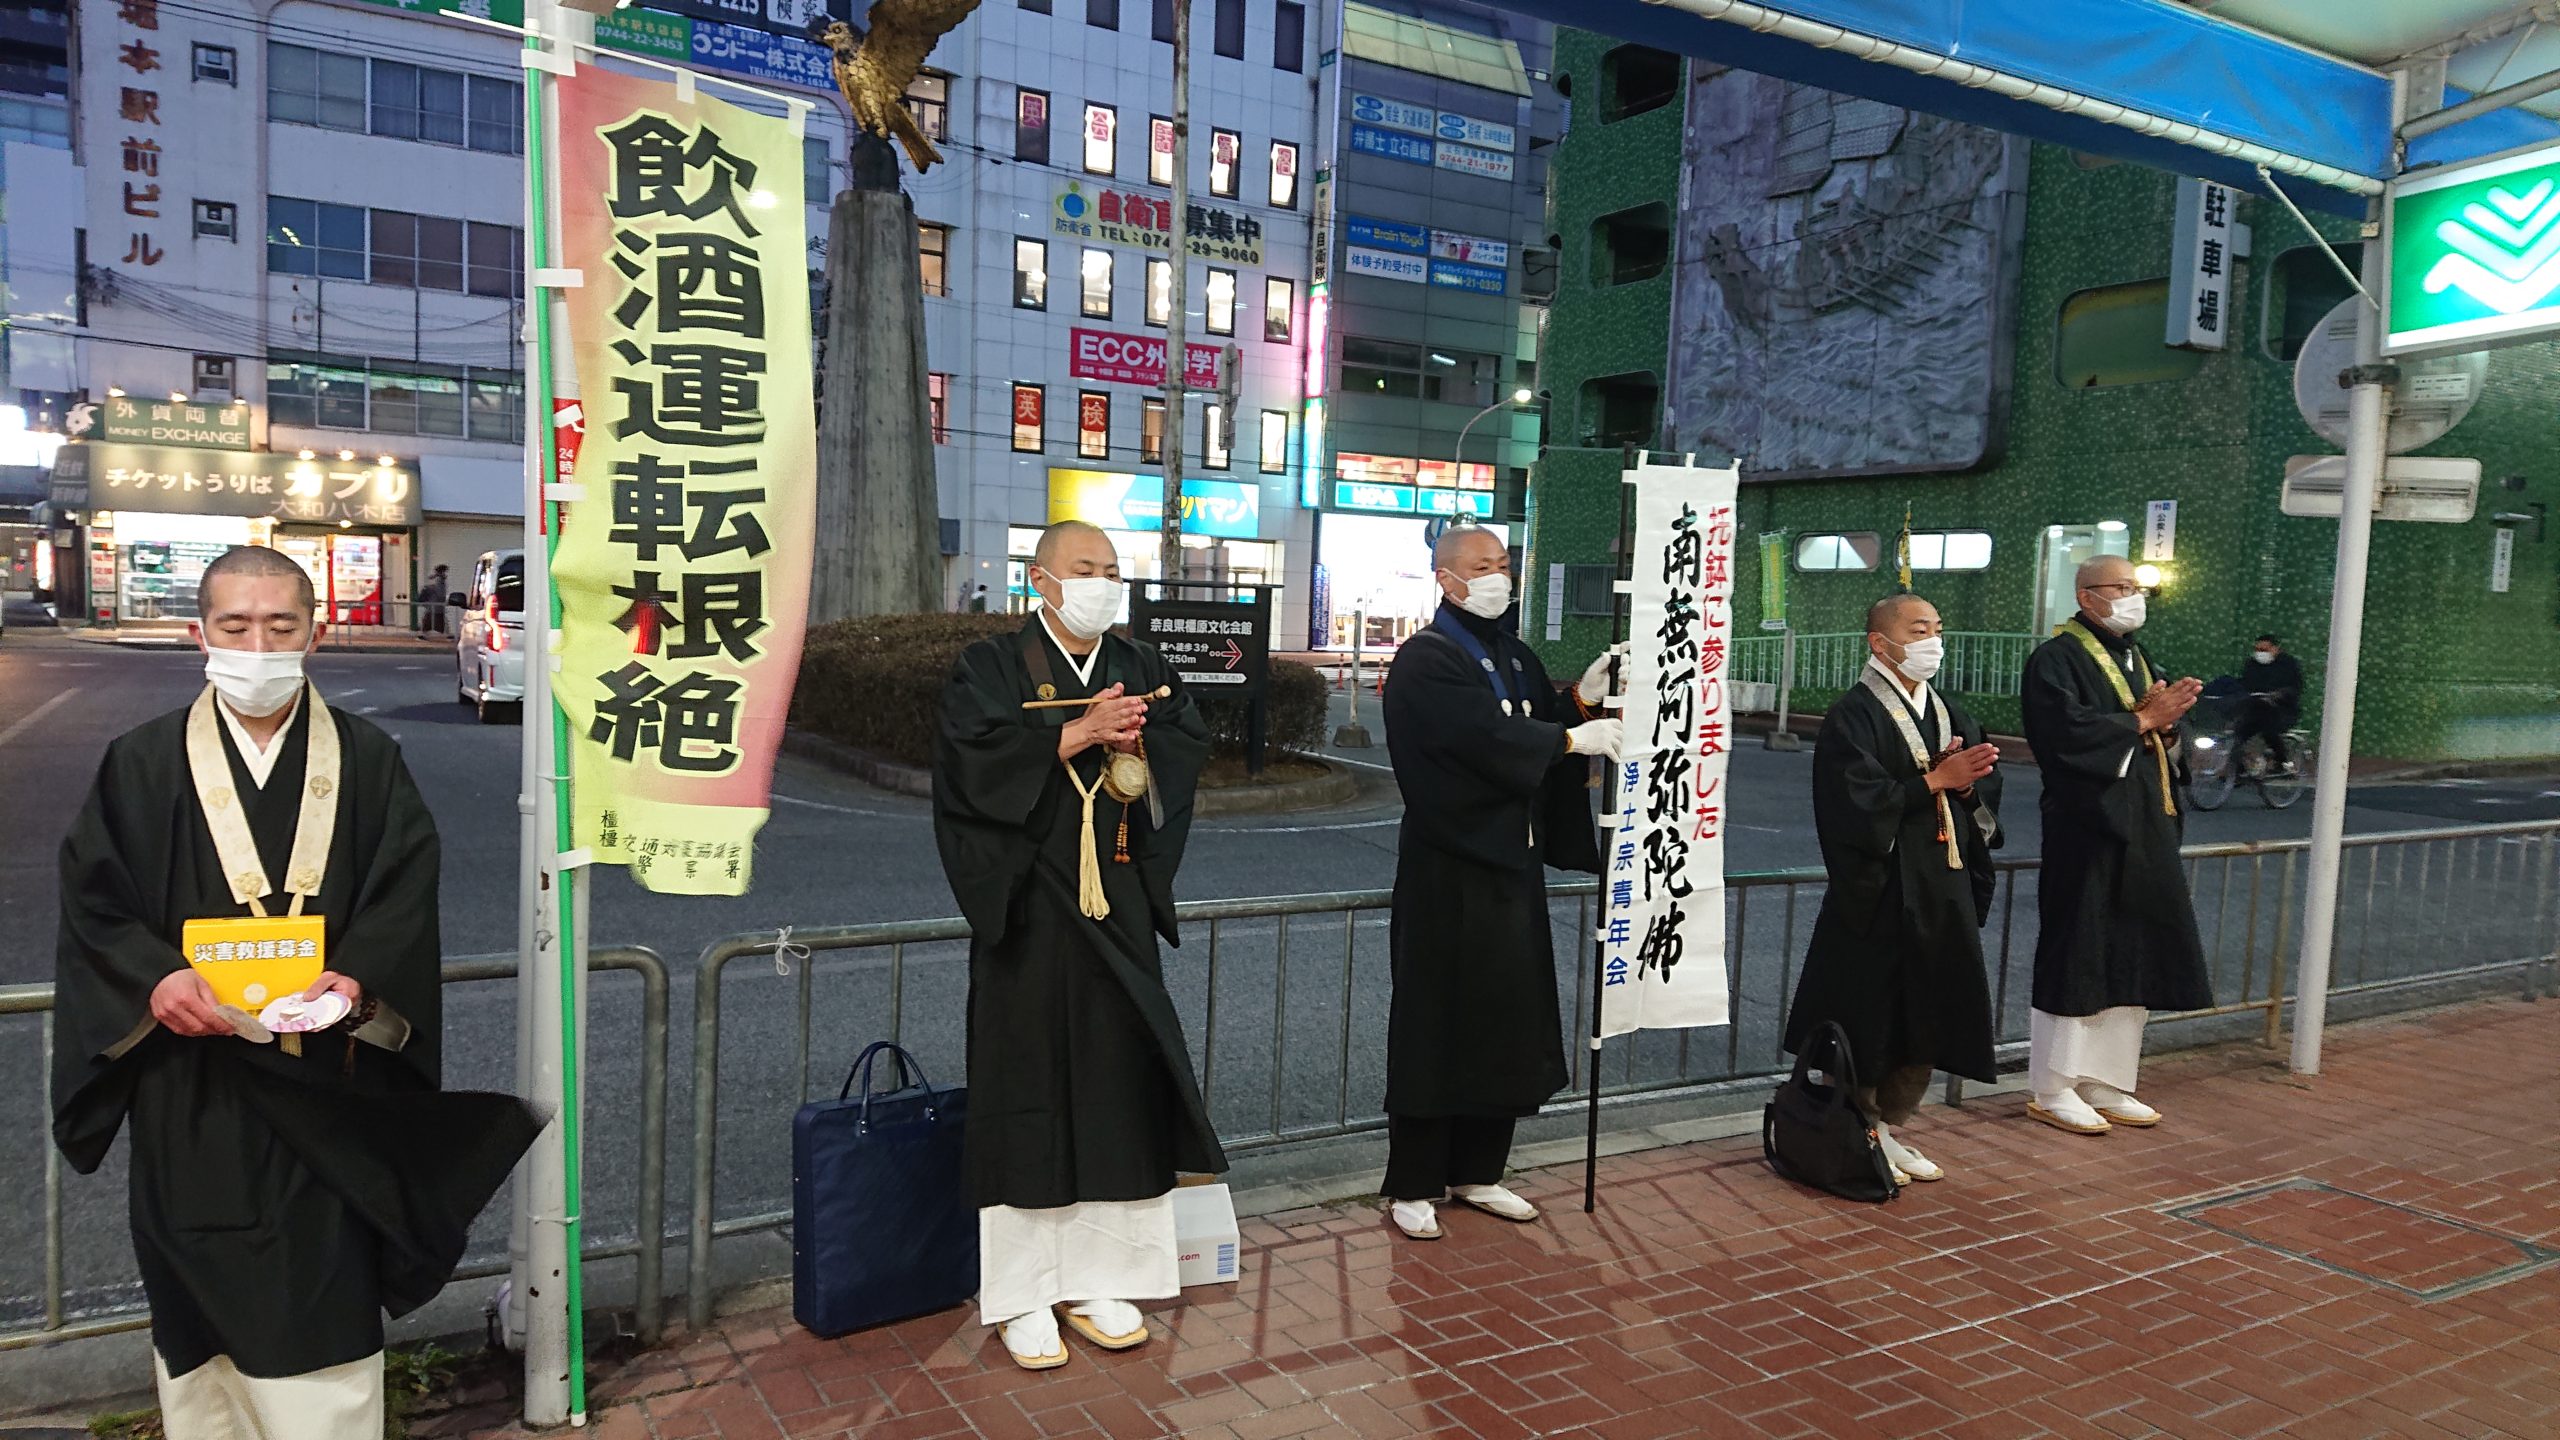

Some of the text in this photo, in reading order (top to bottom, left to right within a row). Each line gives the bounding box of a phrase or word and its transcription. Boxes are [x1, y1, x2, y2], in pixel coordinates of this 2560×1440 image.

[1353, 129, 1386, 152] 弁護士
[1439, 153, 1509, 173] 0744-21-1977
[1351, 252, 1423, 276] 体験予約受付中
[2196, 185, 2226, 332] 駐車場
[115, 401, 240, 427] 外貨両替
[1018, 393, 1039, 421] 英
[1082, 401, 1105, 428] 検
[108, 426, 246, 446] MONEY EXCHANGE
[586, 113, 771, 772] 飲酒運転根絶
[105, 467, 273, 495] チケットうりば
[283, 470, 408, 503] カプリ
[271, 498, 407, 521] 大和八木店
[1150, 618, 1253, 635] 奈良県橿原文化会館
[1163, 654, 1197, 664] 250m
[1692, 505, 1731, 841] 托鉢に参りました
[1605, 761, 1640, 987] 浄土宗青年会
[194, 938, 317, 964] 災害救援募金
[1178, 1251, 1200, 1262] .com
